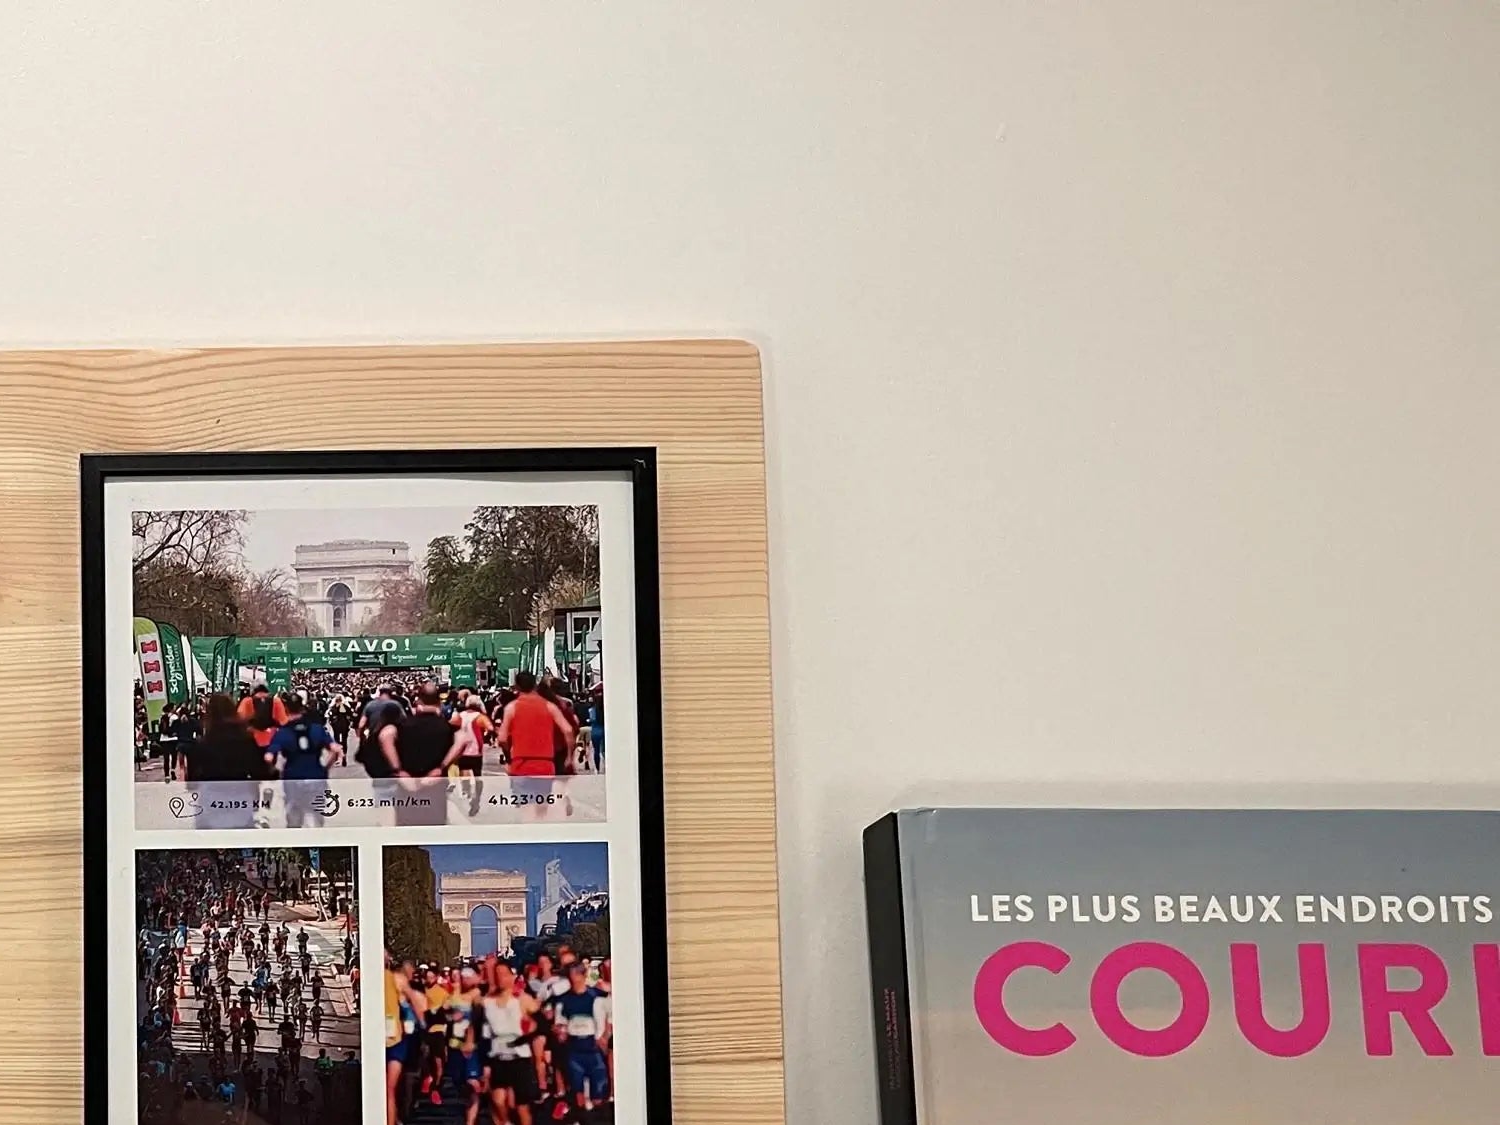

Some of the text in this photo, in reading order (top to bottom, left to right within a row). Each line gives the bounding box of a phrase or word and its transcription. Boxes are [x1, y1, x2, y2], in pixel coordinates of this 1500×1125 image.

[312, 639, 397, 652] BRAVO
[210, 800, 271, 809] 42.195 KM
[347, 796, 431, 807] 6:23 min/km
[970, 894, 1493, 924] LES PLUS BEAUX ENDROITS
[973, 941, 1500, 1057] COURI
